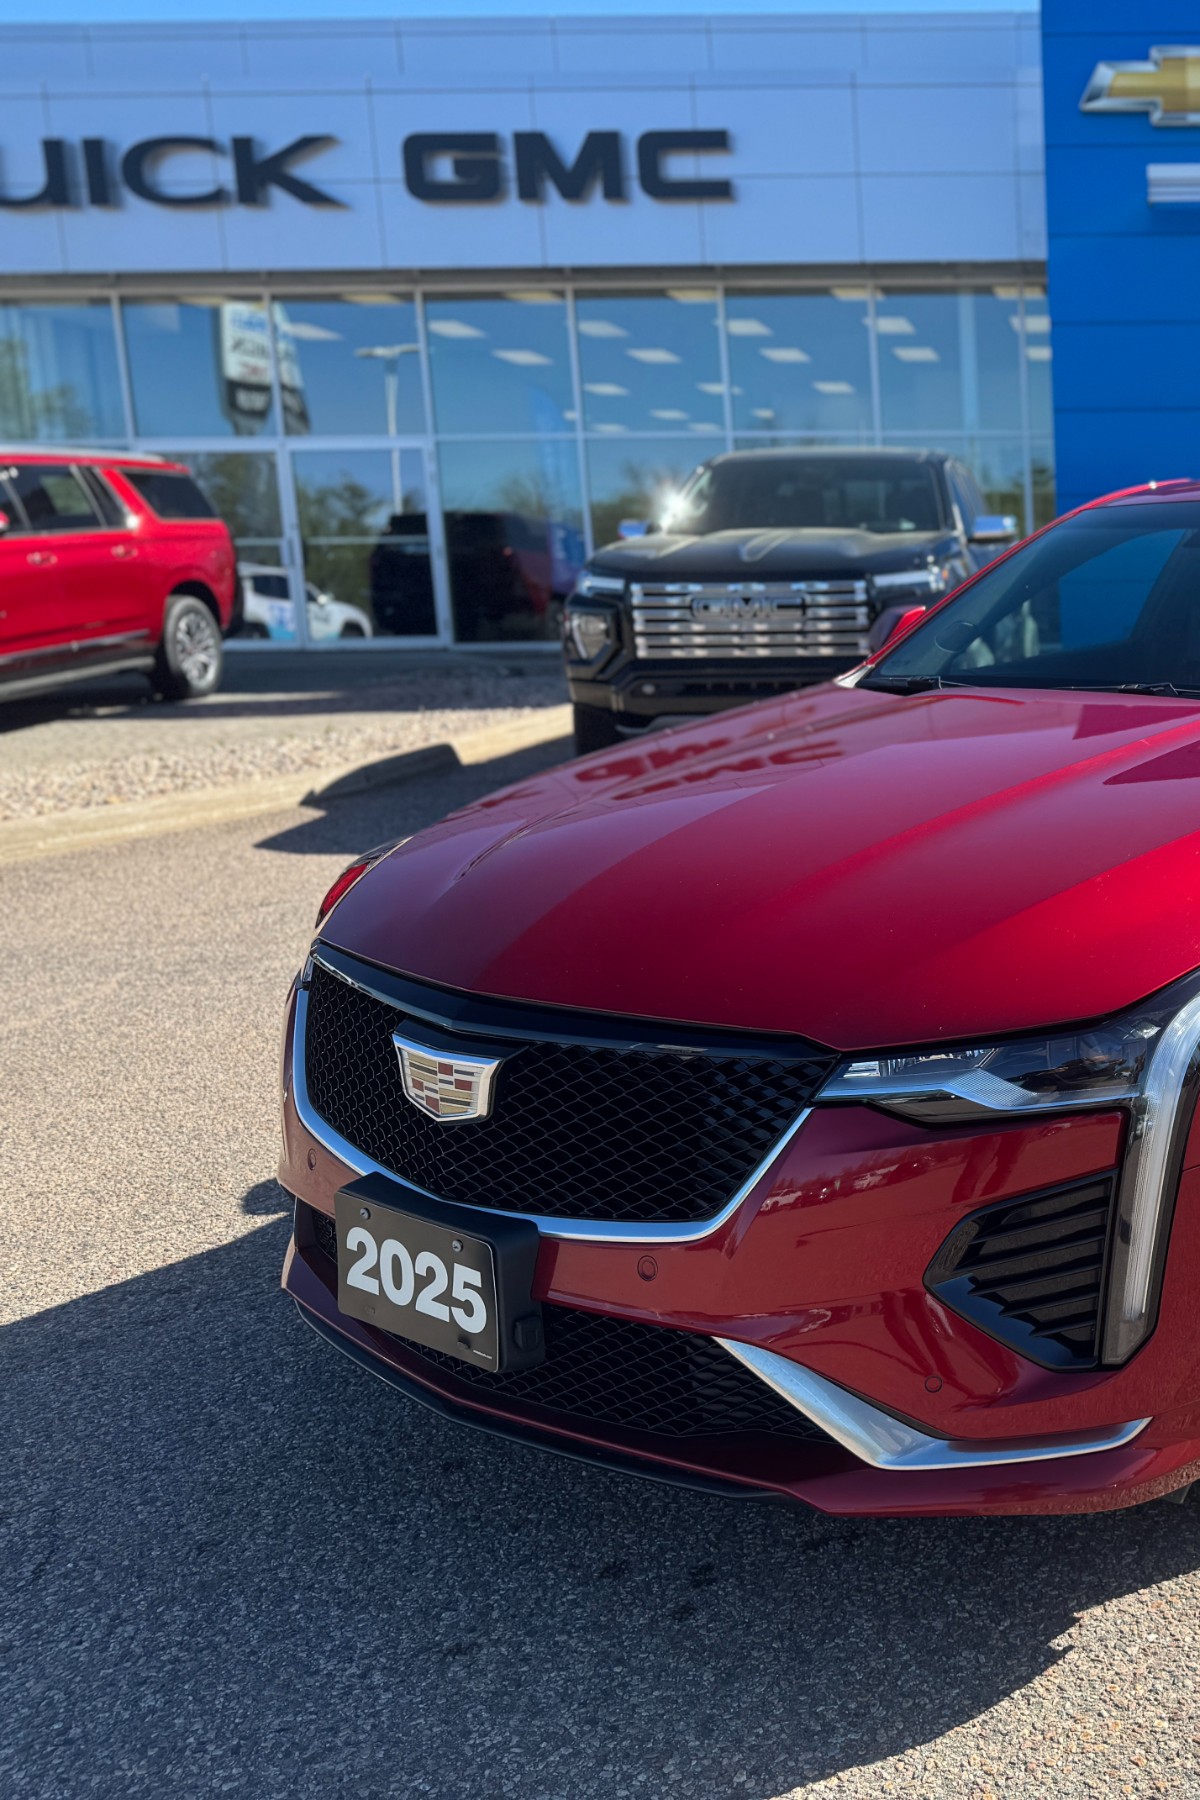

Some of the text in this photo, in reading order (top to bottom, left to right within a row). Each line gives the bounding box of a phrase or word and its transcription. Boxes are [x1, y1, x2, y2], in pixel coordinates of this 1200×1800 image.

[402, 130, 736, 204] GMC
[691, 597, 804, 619] GMC
[346, 1226, 487, 1334] 2025
